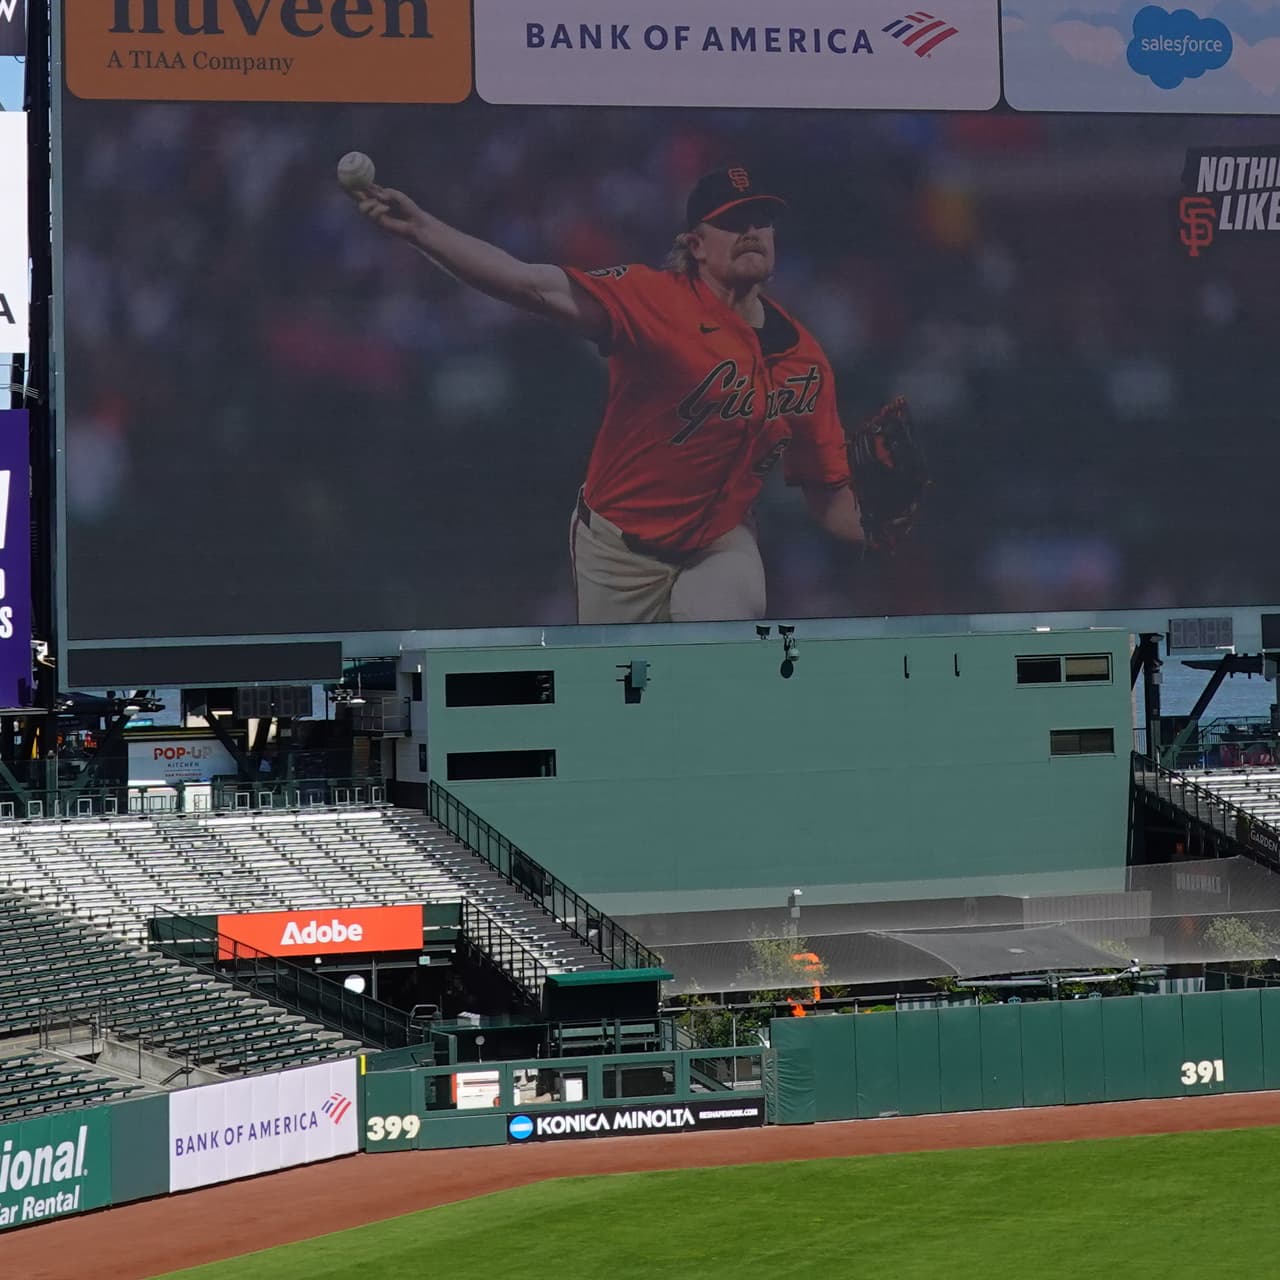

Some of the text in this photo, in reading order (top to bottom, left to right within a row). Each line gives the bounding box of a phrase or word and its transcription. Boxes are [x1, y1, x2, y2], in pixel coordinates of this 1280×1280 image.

[526, 22, 874, 55] BANK OF AMERICA
[1141, 35, 1223, 56] salesforce
[106, 50, 294, 76] A TIAA Company
[153, 746, 212, 760] POP-UP
[1250, 830, 1278, 852] GARDEN
[280, 919, 363, 945] Adobe
[1181, 1059, 1224, 1085] 391
[175, 1110, 319, 1157] BANK OF AMERICA
[367, 1114, 421, 1142] 399
[537, 1108, 695, 1136] KONICA MINOLTA
[22, 1185, 79, 1220] Rental
